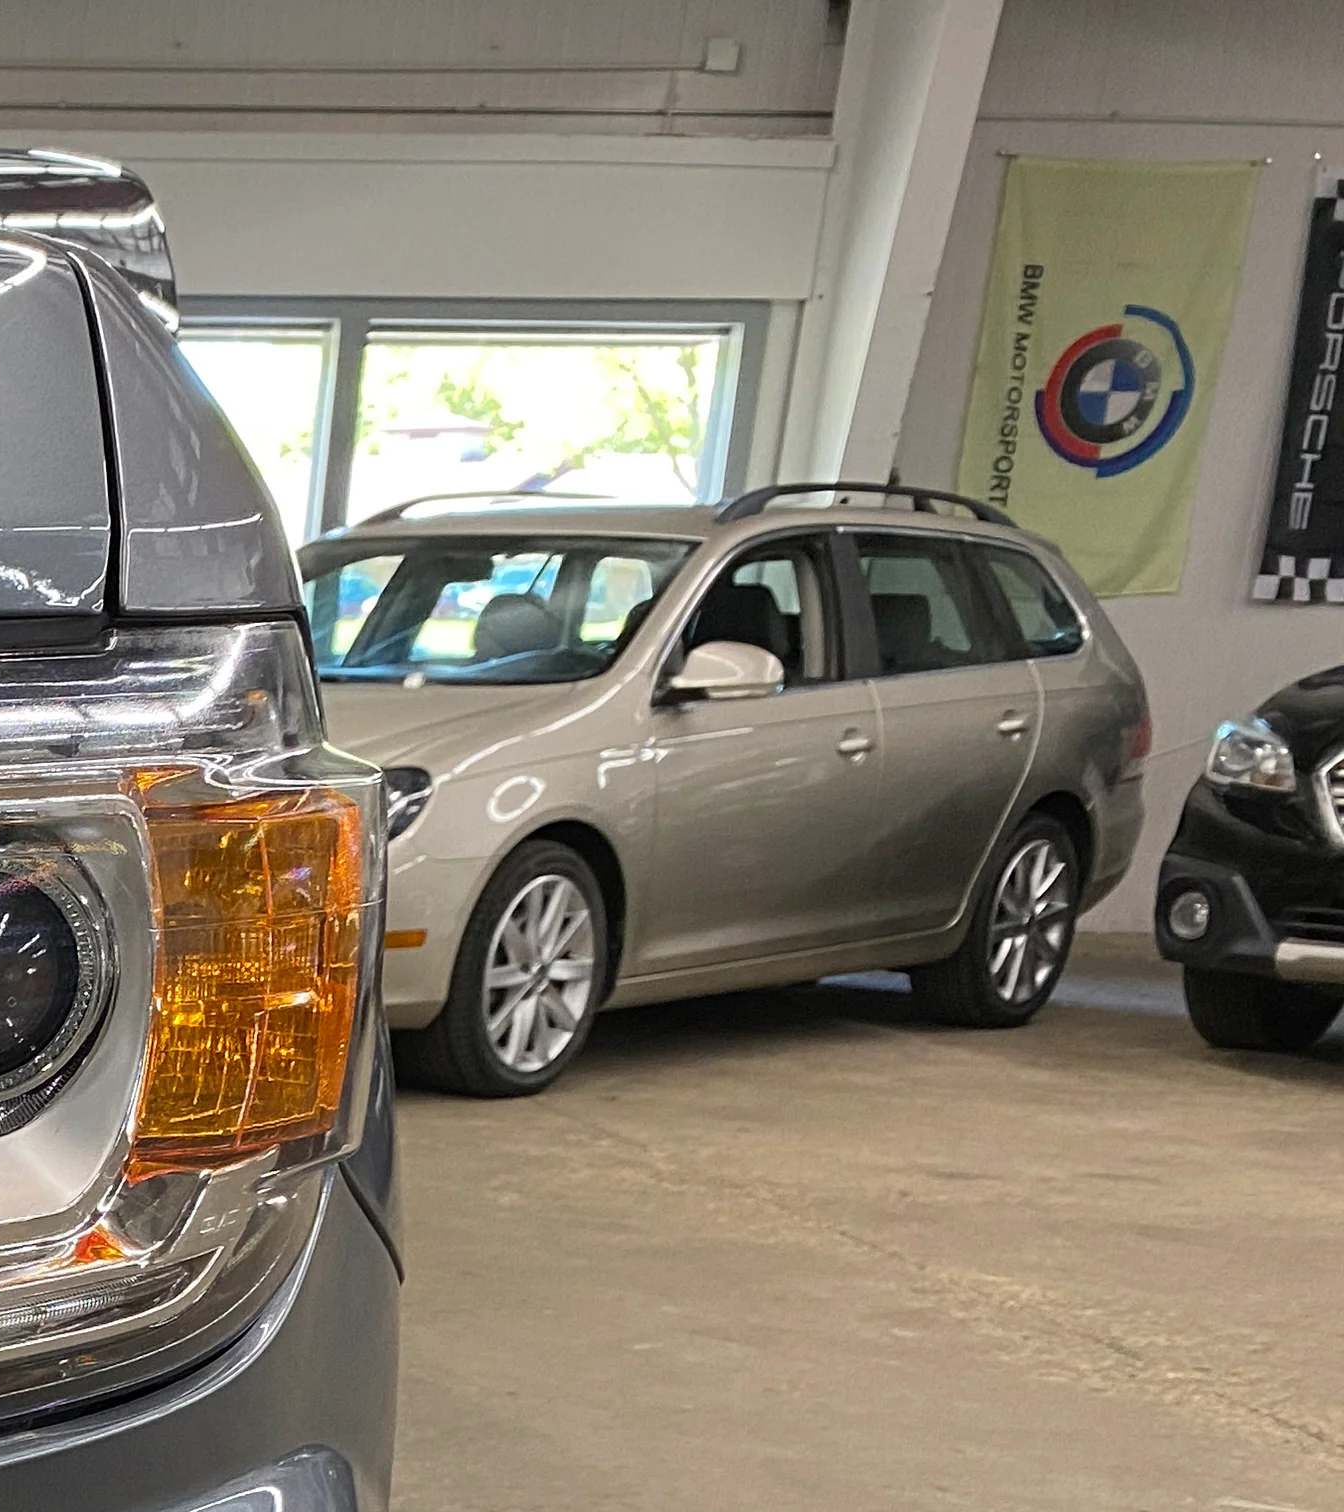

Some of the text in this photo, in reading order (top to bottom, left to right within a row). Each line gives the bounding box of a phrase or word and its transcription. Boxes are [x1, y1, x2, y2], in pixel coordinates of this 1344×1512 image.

[988, 263, 1045, 507] BMW MOTORSPORT
[1288, 249, 1344, 530] ORSCHE
